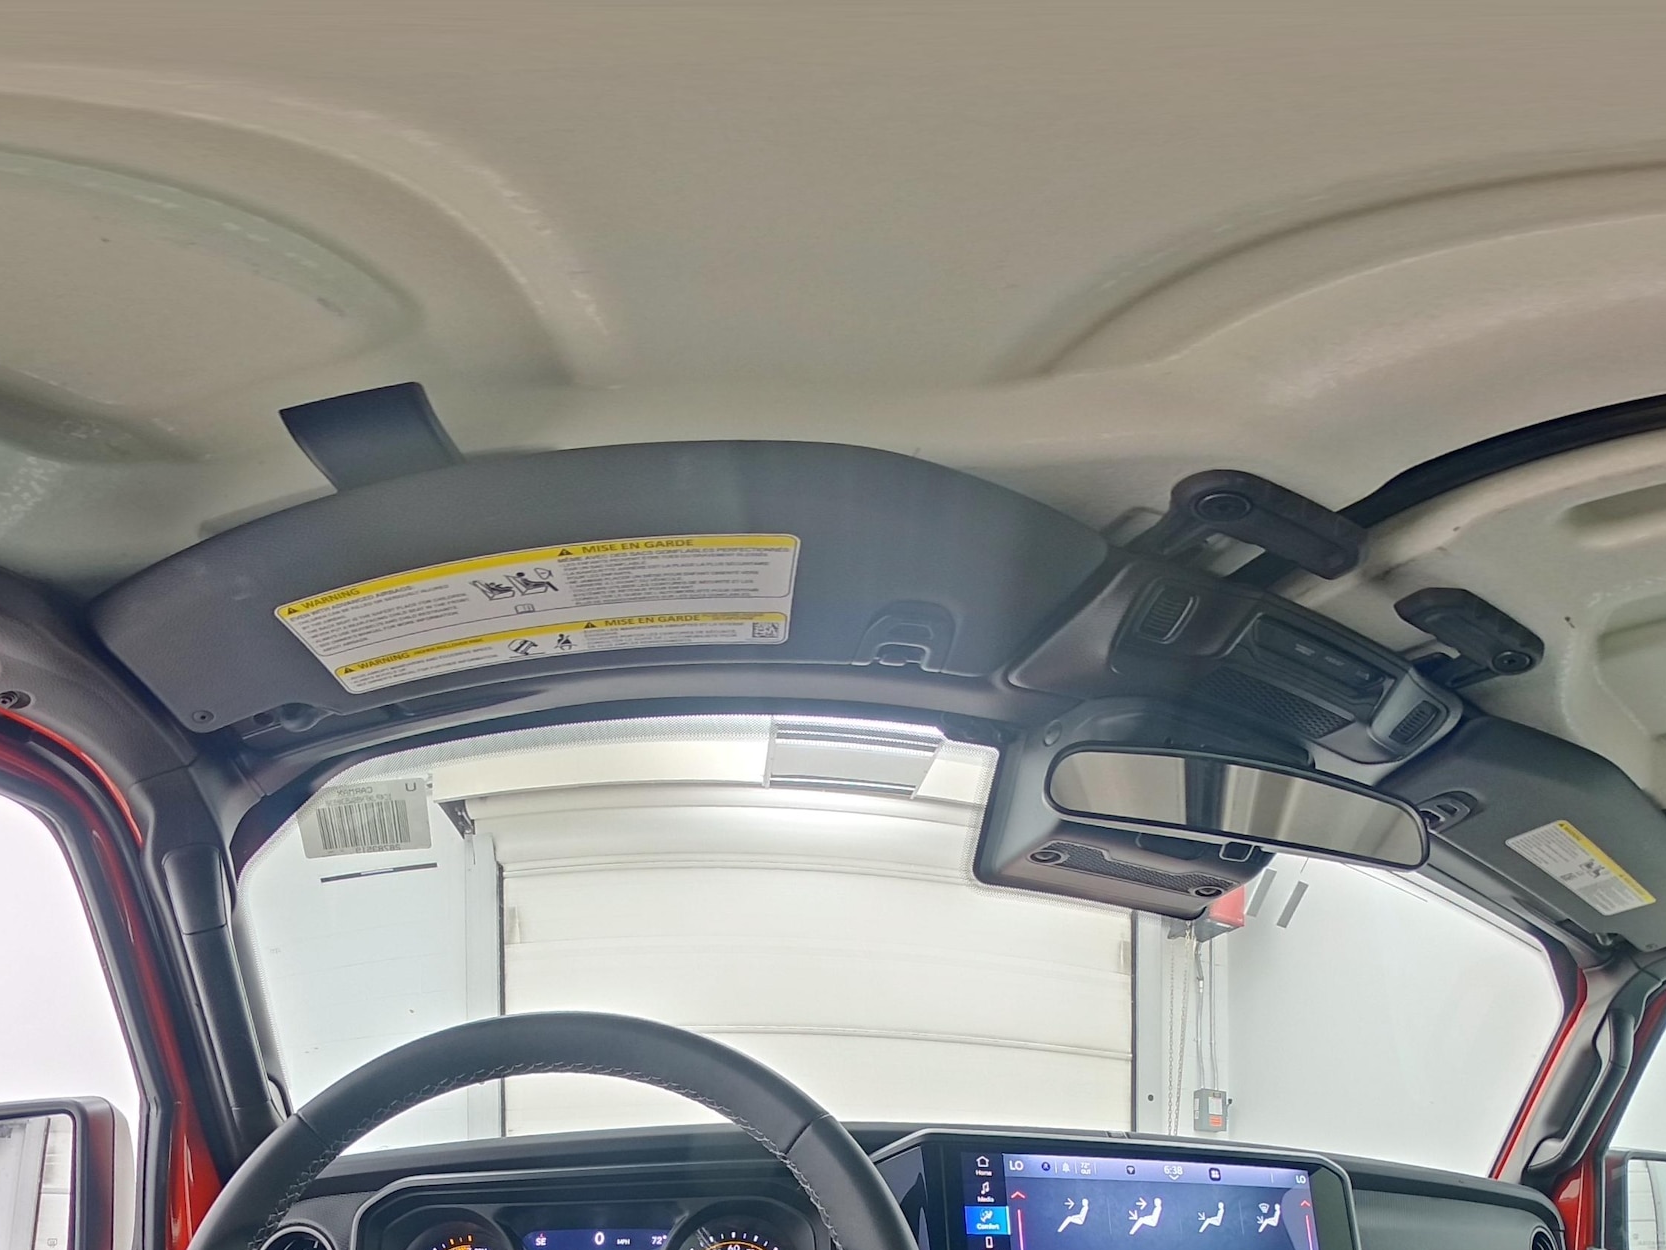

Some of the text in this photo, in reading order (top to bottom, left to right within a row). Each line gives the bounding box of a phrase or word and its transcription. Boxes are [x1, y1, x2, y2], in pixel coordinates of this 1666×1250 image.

[582, 539, 694, 554] MISE EN GARDE
[301, 588, 361, 610] WARNING
[604, 618, 635, 627] MISE
[638, 616, 656, 624] EN
[658, 614, 701, 623] GARDE
[357, 652, 411, 671] WARNING
[1009, 1160, 1024, 1171] LO
[1163, 1165, 1183, 1176] 6:38
[1295, 1174, 1307, 1184] LO
[976, 1222, 1000, 1231] Comfort
[535, 1237, 547, 1246] SE
[594, 1231, 605, 1246] 0
